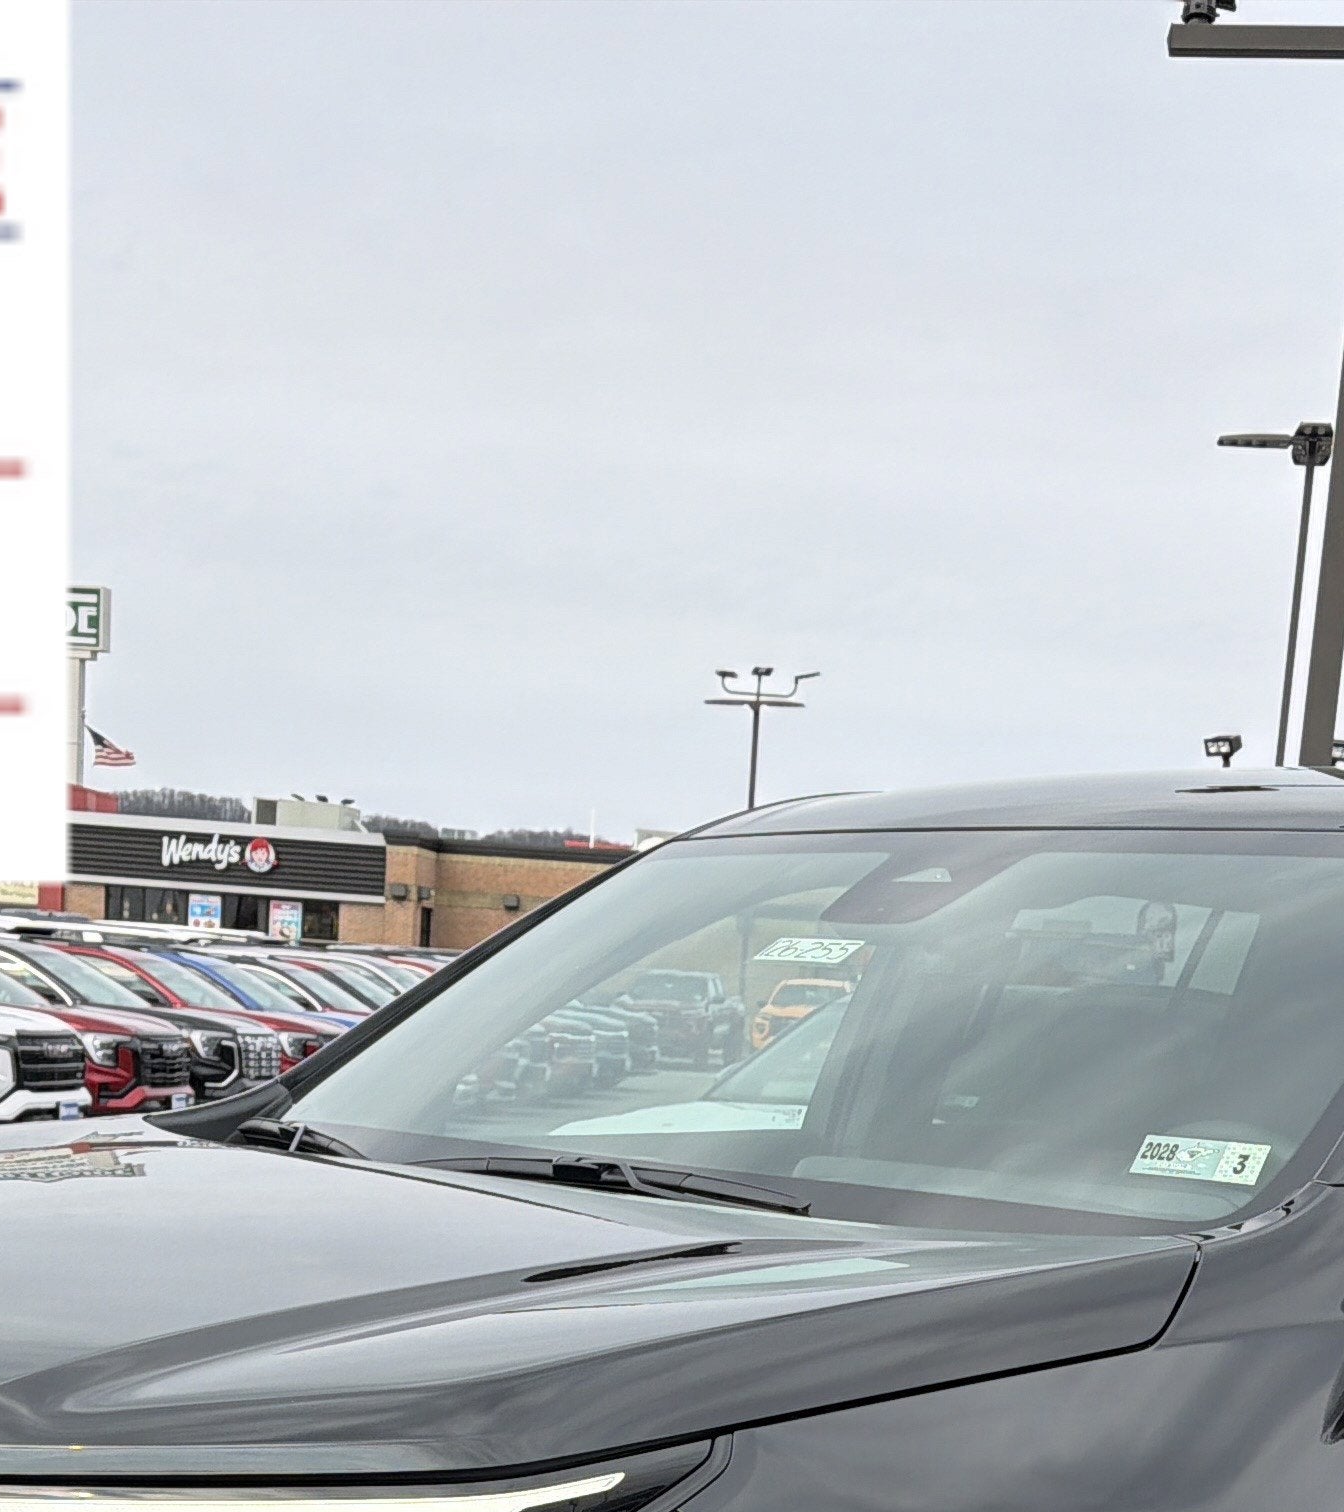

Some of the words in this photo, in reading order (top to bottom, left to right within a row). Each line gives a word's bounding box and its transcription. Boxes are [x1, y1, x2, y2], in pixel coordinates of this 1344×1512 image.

[161, 833, 242, 870] Wendy's
[1140, 1141, 1180, 1161] 2028
[1232, 1153, 1251, 1175] 3
